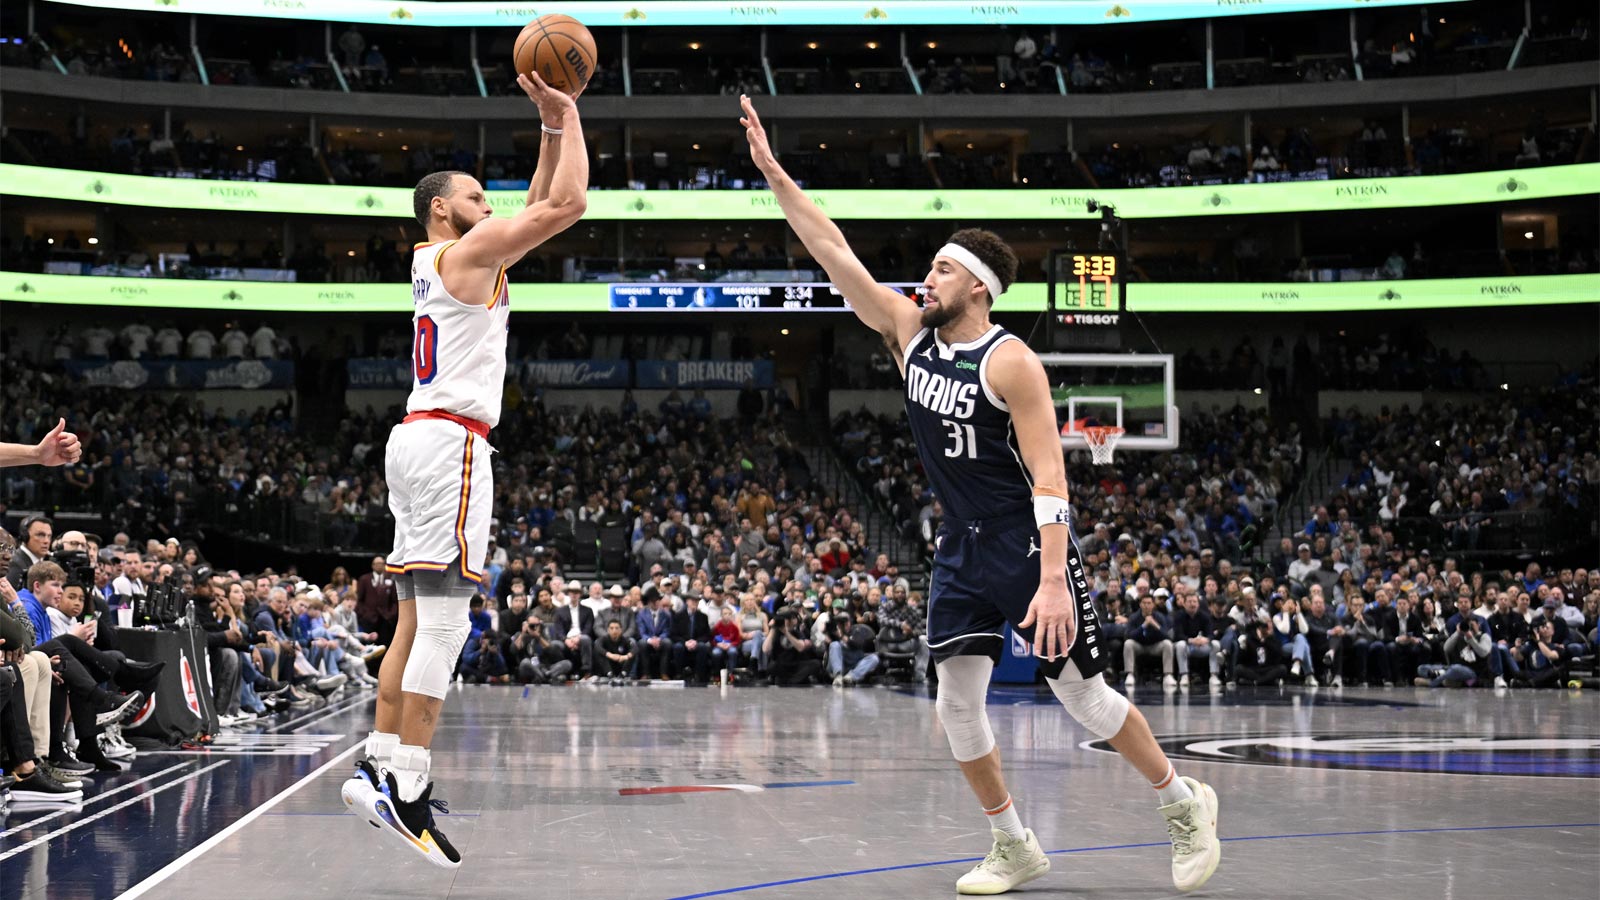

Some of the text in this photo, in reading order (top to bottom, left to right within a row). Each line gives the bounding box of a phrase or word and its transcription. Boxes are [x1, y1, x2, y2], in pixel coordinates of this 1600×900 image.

[1072, 255, 1116, 276] 3:33
[627, 295, 638, 308] 3
[666, 295, 676, 308] 5
[735, 295, 760, 308] 101
[658, 286, 685, 296] FOULS
[721, 286, 772, 296] MAVERICKS
[783, 286, 814, 300] 3:34
[1079, 275, 1112, 309] 17
[1073, 314, 1119, 325] TISSOT
[678, 360, 754, 385] BREAKERS
[955, 359, 978, 371] chime
[907, 363, 979, 419] MAVS
[942, 419, 977, 459] 31
